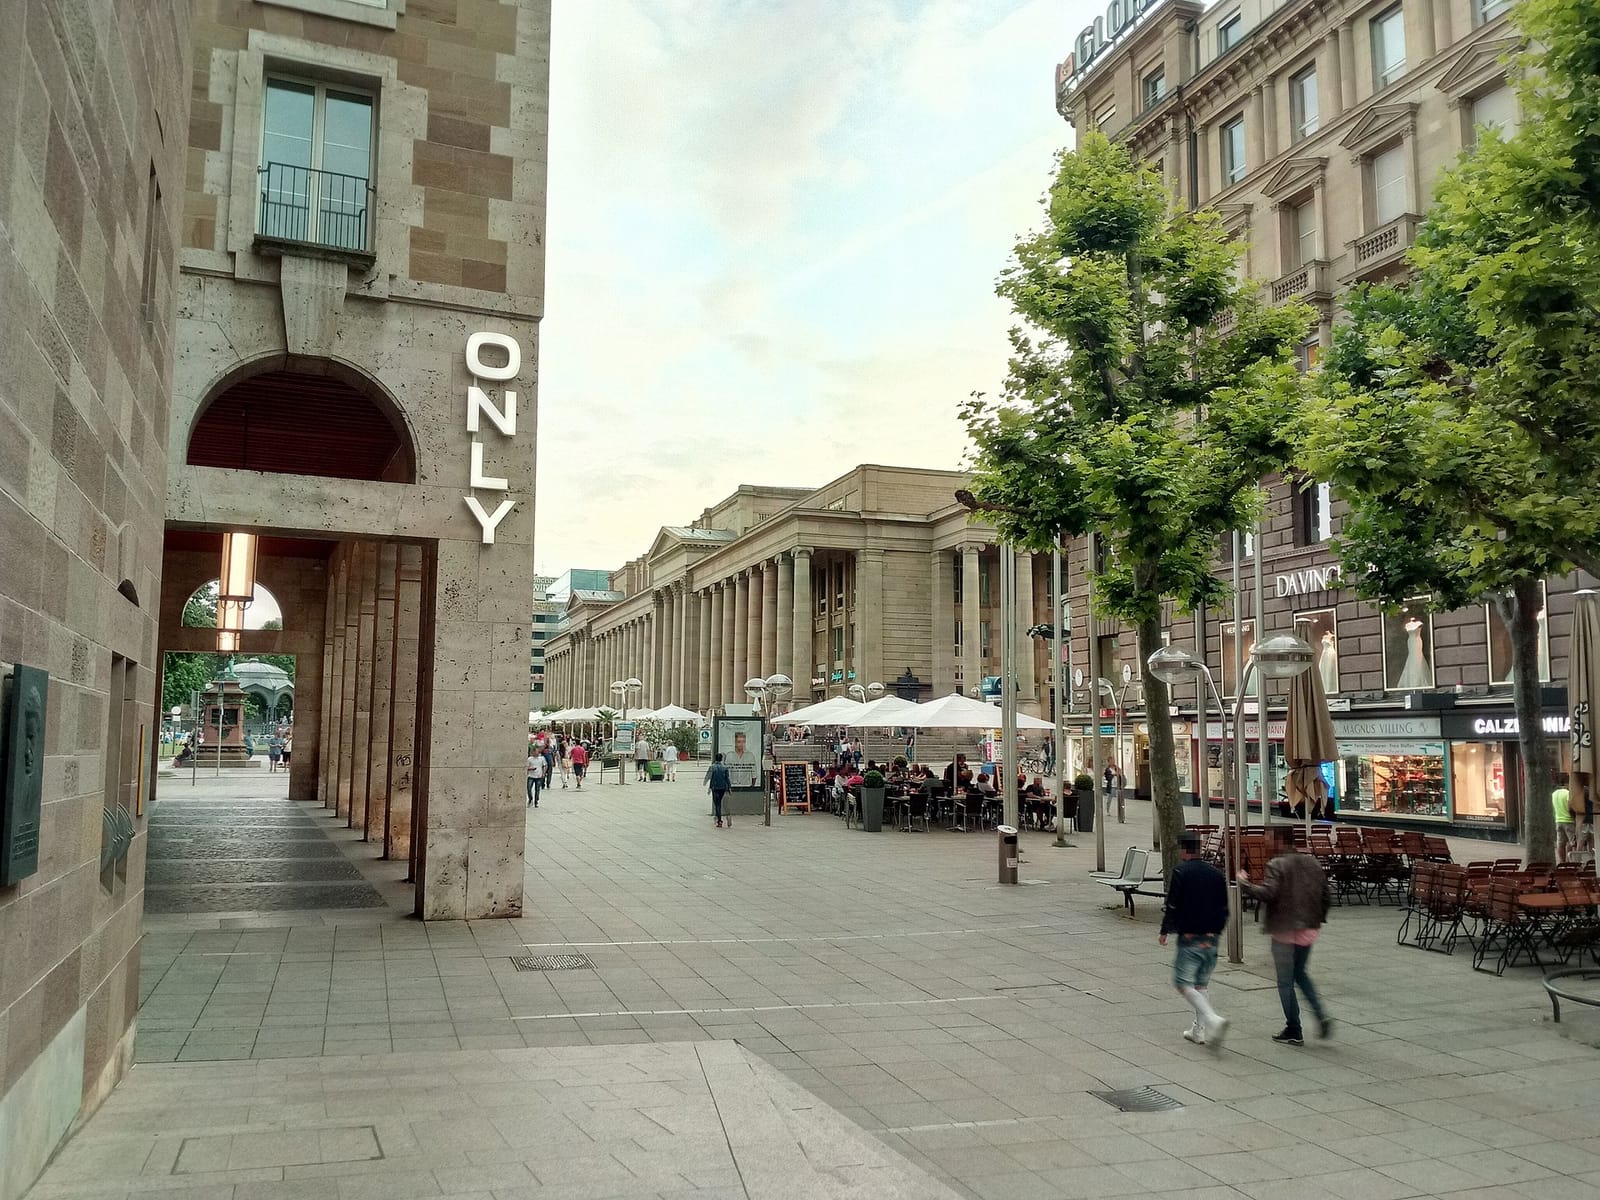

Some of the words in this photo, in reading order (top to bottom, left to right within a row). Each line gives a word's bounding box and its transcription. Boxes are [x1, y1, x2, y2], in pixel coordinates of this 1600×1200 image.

[464, 331, 521, 545] ONLY
[1343, 723, 1376, 735] MAGNUS
[1380, 721, 1413, 735] VILLING
